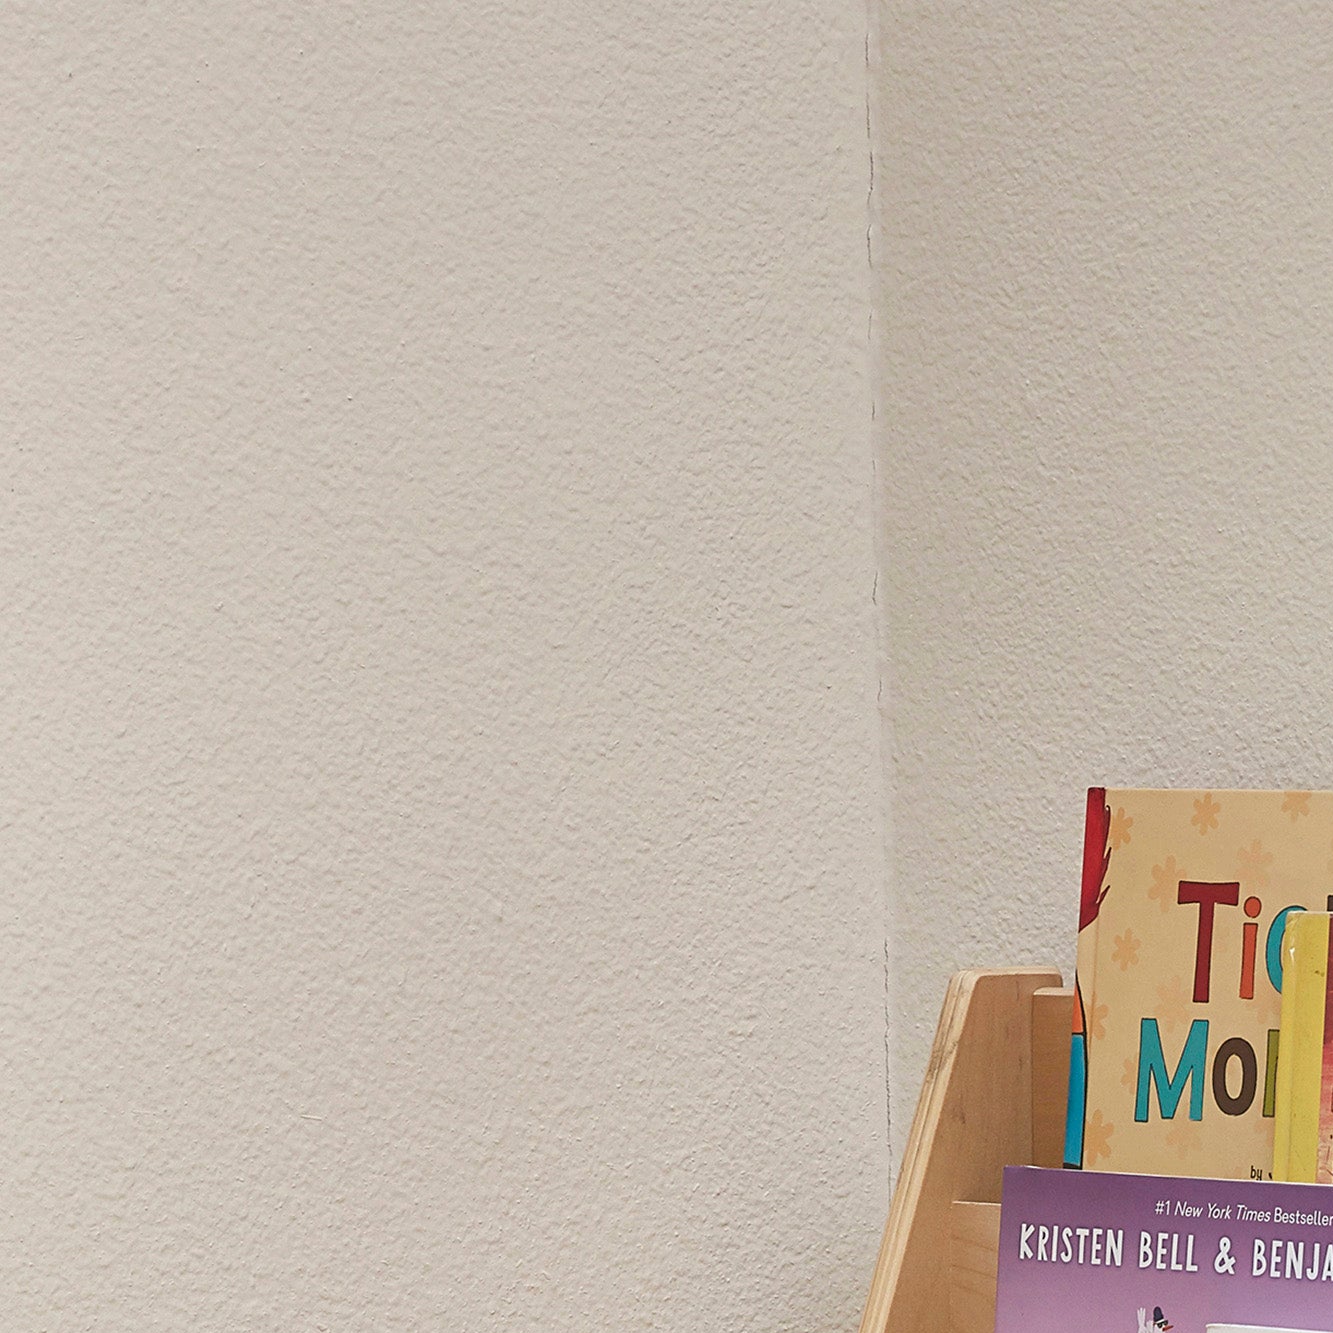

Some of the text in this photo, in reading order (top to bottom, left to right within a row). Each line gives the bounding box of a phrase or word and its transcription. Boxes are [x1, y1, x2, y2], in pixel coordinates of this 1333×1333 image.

[1154, 1200, 1171, 1216] #1
[1174, 1200, 1204, 1218] New
[1207, 1202, 1233, 1220] York
[1236, 1204, 1272, 1223] Times
[1018, 1223, 1123, 1268] KRISTEN
[1138, 1231, 1198, 1273] BELL
[1213, 1237, 1236, 1276] &
